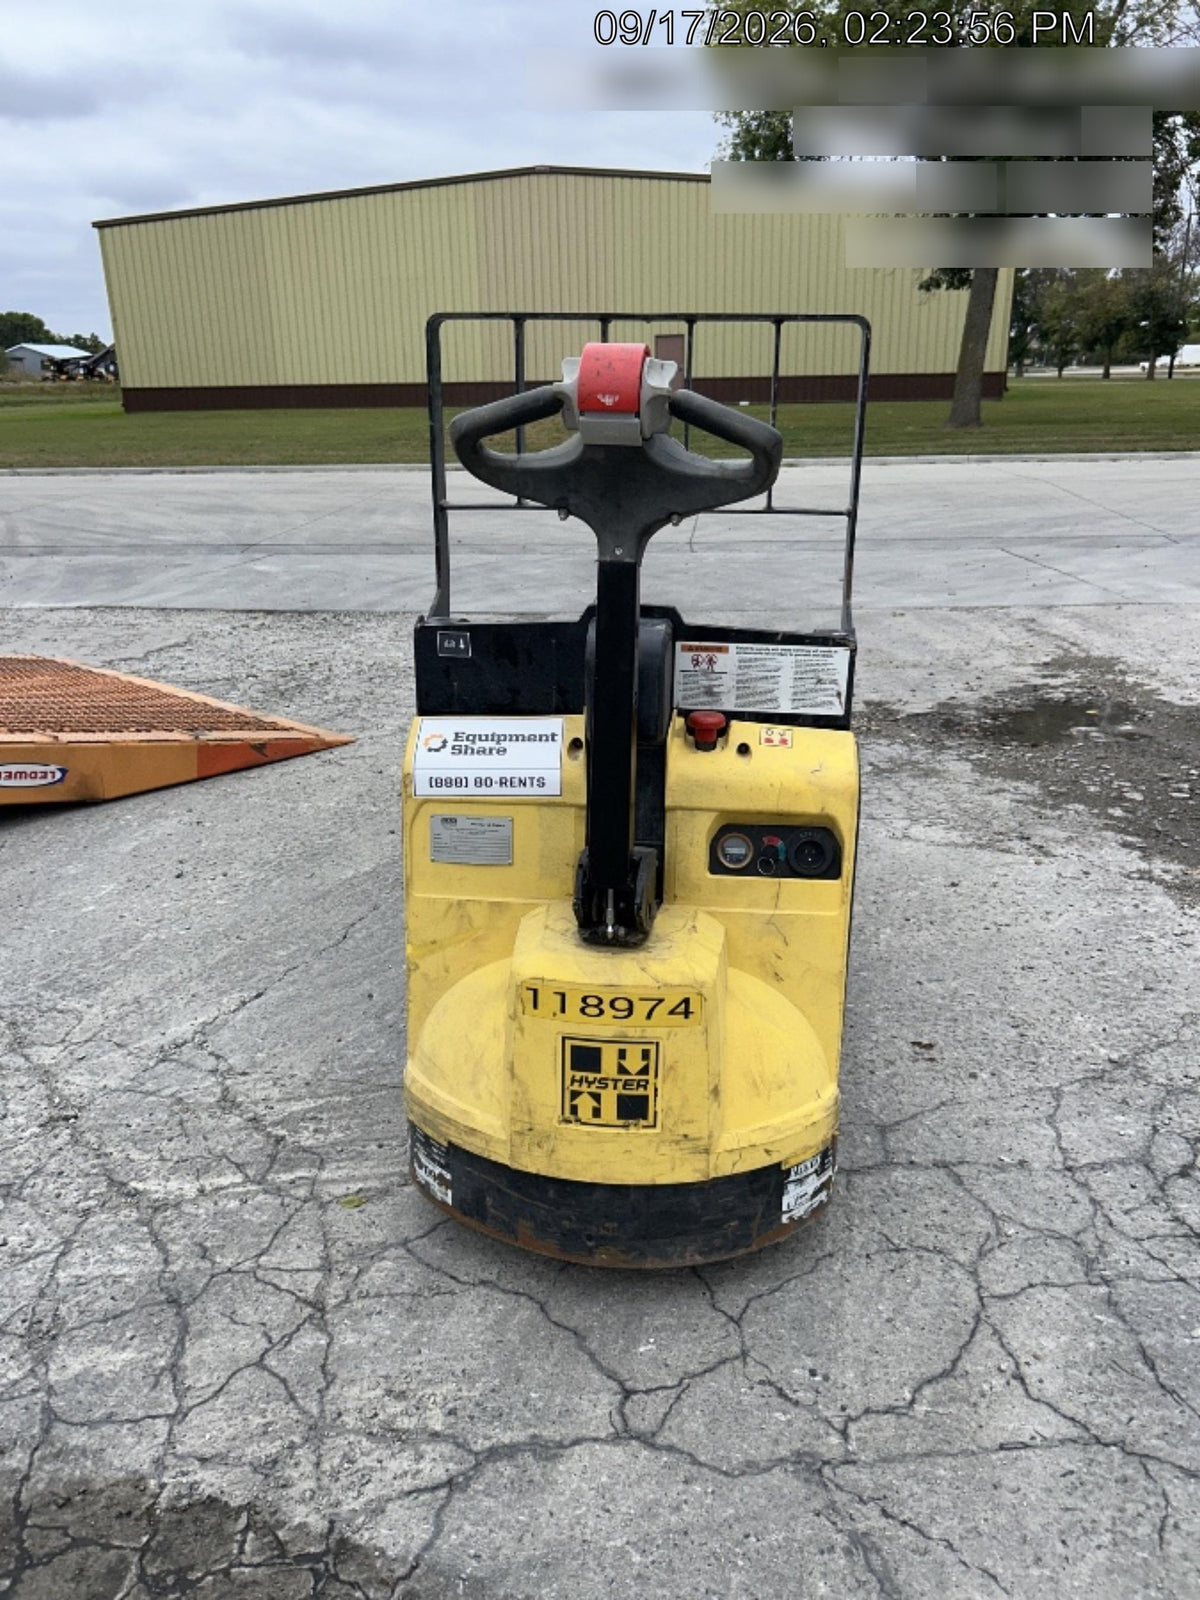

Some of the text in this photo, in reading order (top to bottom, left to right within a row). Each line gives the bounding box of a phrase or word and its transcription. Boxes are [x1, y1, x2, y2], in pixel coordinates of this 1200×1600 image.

[453, 732, 559, 745] Equipment
[451, 744, 508, 756] Share
[0, 770, 56, 780] LEDWE
[526, 986, 695, 1021] 118974
[569, 1074, 650, 1092] HYSTER
